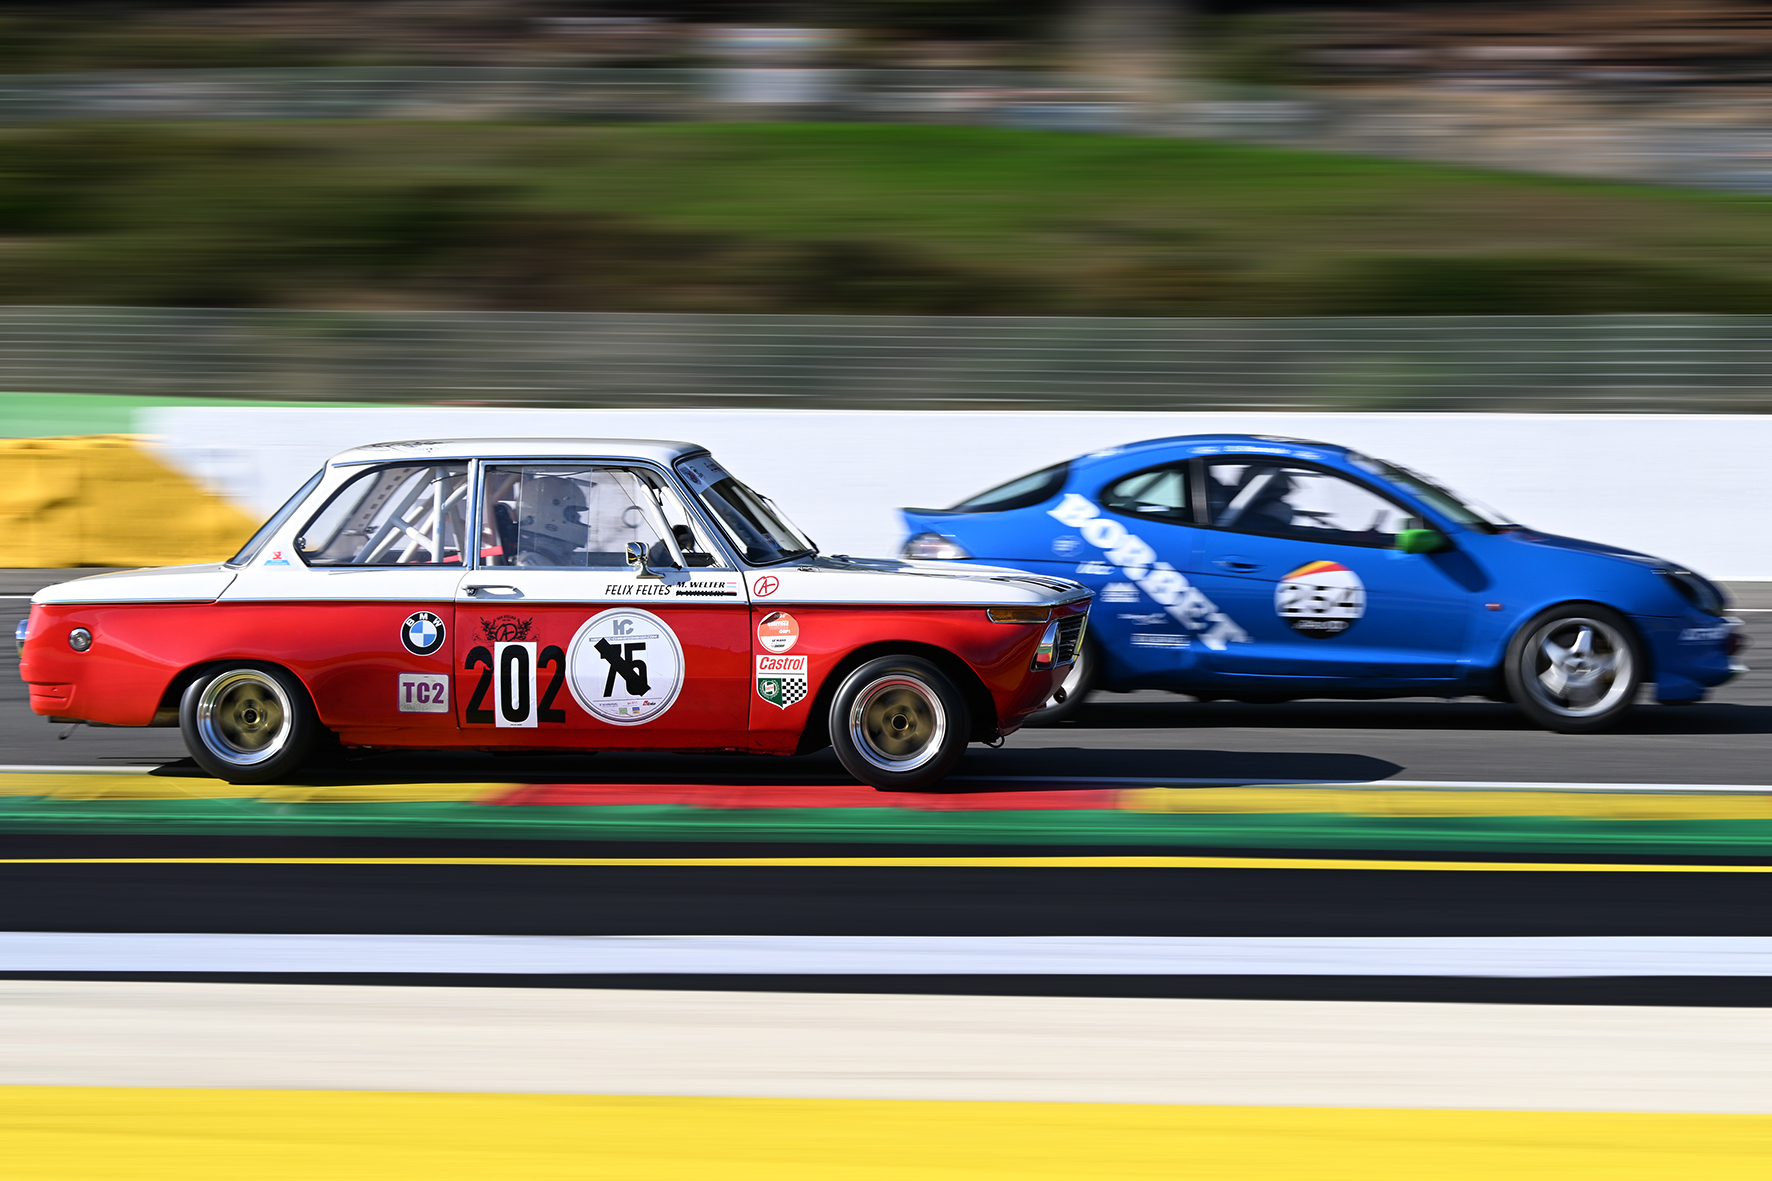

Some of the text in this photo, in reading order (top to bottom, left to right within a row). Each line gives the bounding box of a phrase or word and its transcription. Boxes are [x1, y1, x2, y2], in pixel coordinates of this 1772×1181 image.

[1046, 493, 1254, 650] BORBET
[605, 584, 633, 596] FELIX
[636, 584, 672, 596] FELTES
[1277, 585, 1364, 613] 254
[405, 613, 442, 627] BMW
[759, 656, 805, 670] Castrol
[403, 682, 445, 704] TC2
[464, 644, 566, 724] 202
